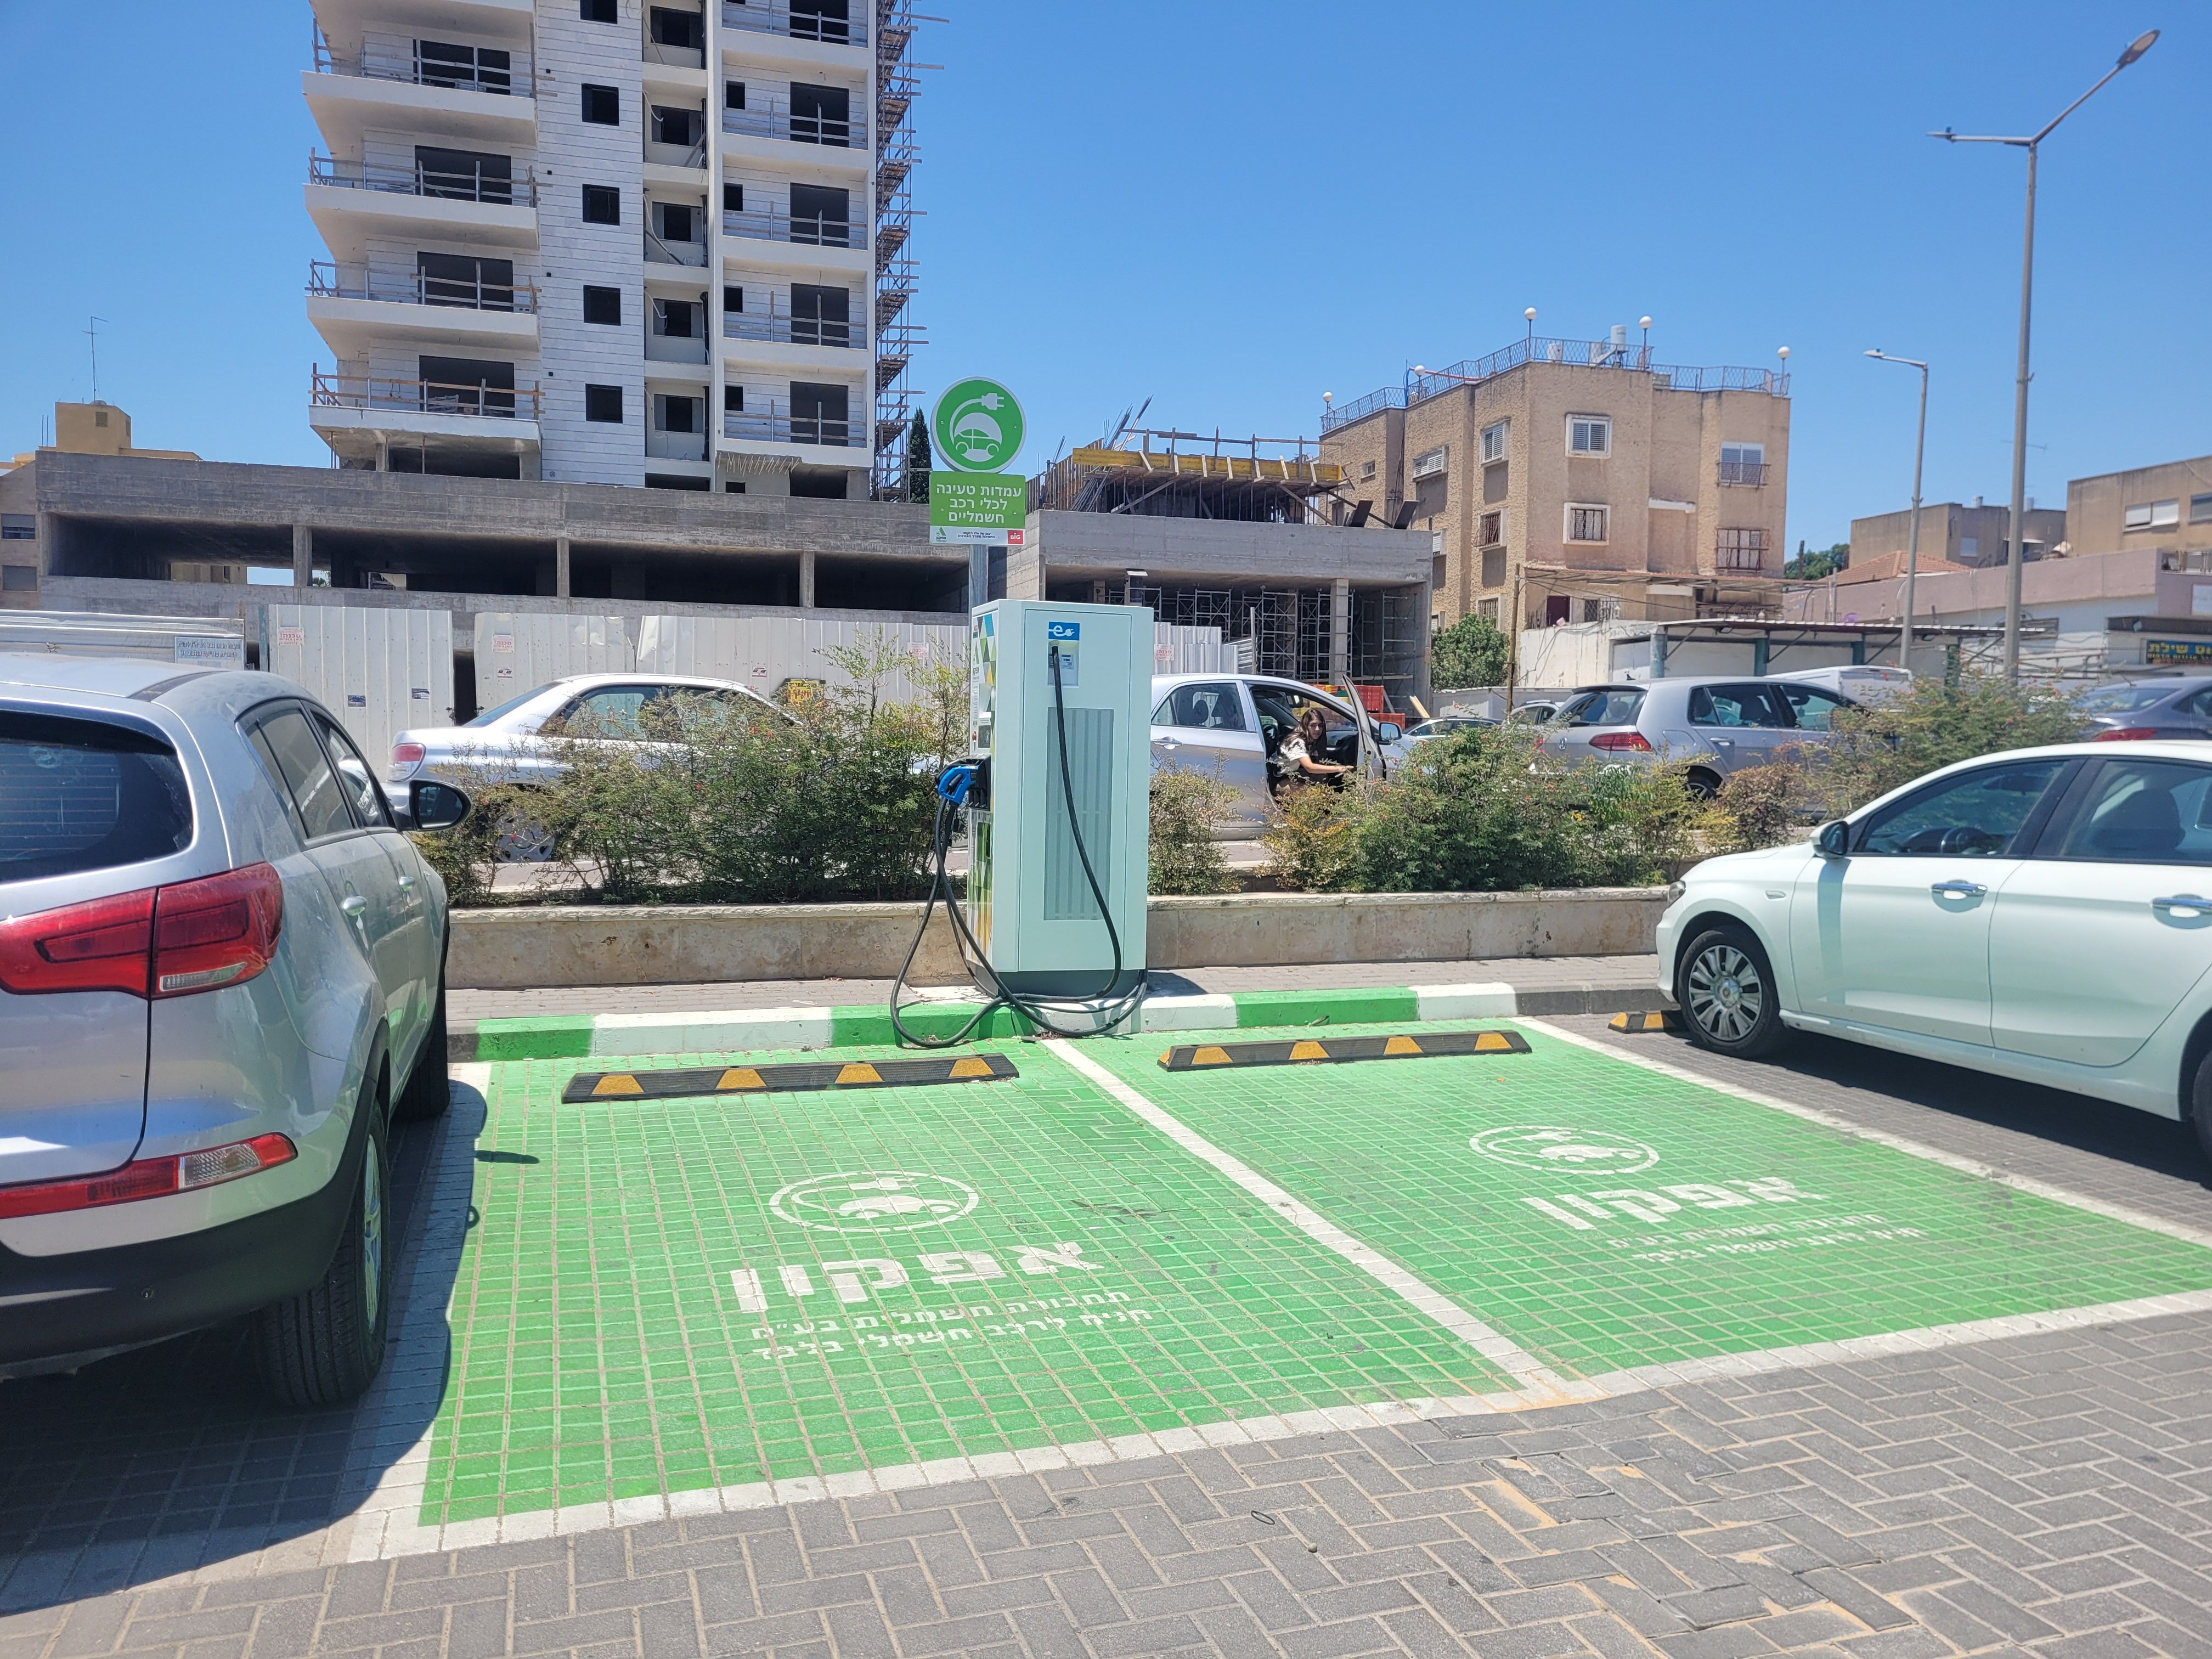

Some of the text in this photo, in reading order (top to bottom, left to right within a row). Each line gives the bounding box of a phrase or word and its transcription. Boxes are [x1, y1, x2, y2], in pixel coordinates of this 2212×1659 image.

[936, 484, 1022, 497] עמדות טעינה
[950, 498, 1008, 510] לכלי רכב
[949, 510, 1005, 523] חשמליים
[1520, 1177, 1831, 1229] אפקון
[1790, 1214, 1887, 1229] תחבורה
[1680, 1223, 1788, 1240] חשמלית
[1705, 1239, 1799, 1254] חשמלי
[1632, 1249, 1708, 1262] בלבד
[730, 1242, 1105, 1313] אפקון
[751, 1291, 1131, 1339] תחבורה חשמלית בע"מ
[752, 1309, 1153, 1360] חניה לרכב חשמלי בלבד
